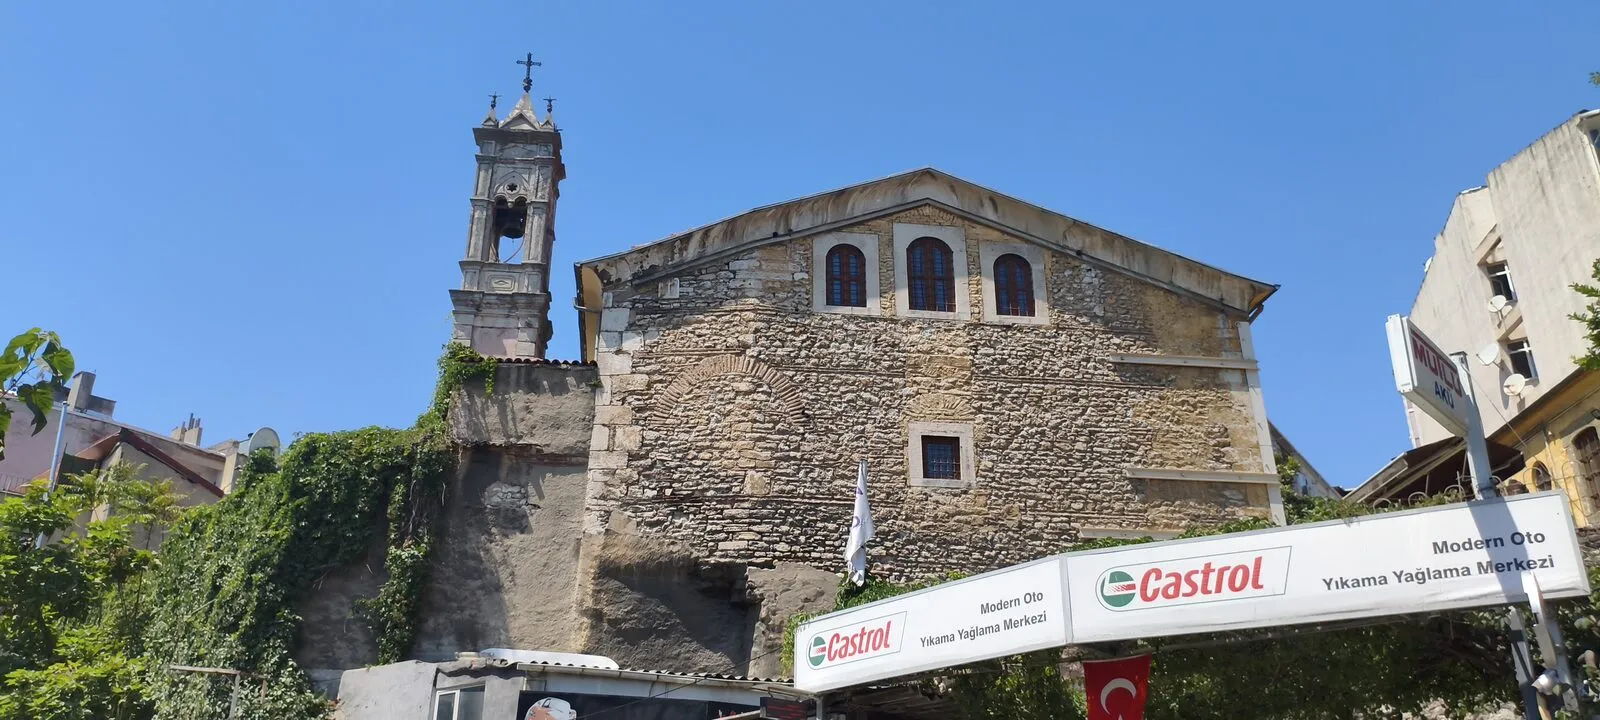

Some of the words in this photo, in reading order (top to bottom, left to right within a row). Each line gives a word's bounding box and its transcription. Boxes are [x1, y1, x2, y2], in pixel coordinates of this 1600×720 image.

[1432, 535, 1505, 555] Modern
[1510, 530, 1545, 546] Oto
[1140, 556, 1264, 603] Castrol
[1322, 575, 1388, 591] Yıkama
[1393, 565, 1471, 585] Yağlama
[1477, 554, 1555, 575] Merkezi
[981, 598, 1021, 614] Modern
[1023, 591, 1044, 604] Oto
[828, 620, 891, 660] Castrol
[920, 633, 955, 648] Yıkama
[957, 623, 1000, 641] Yağlama
[1003, 610, 1047, 631] Merkezi
